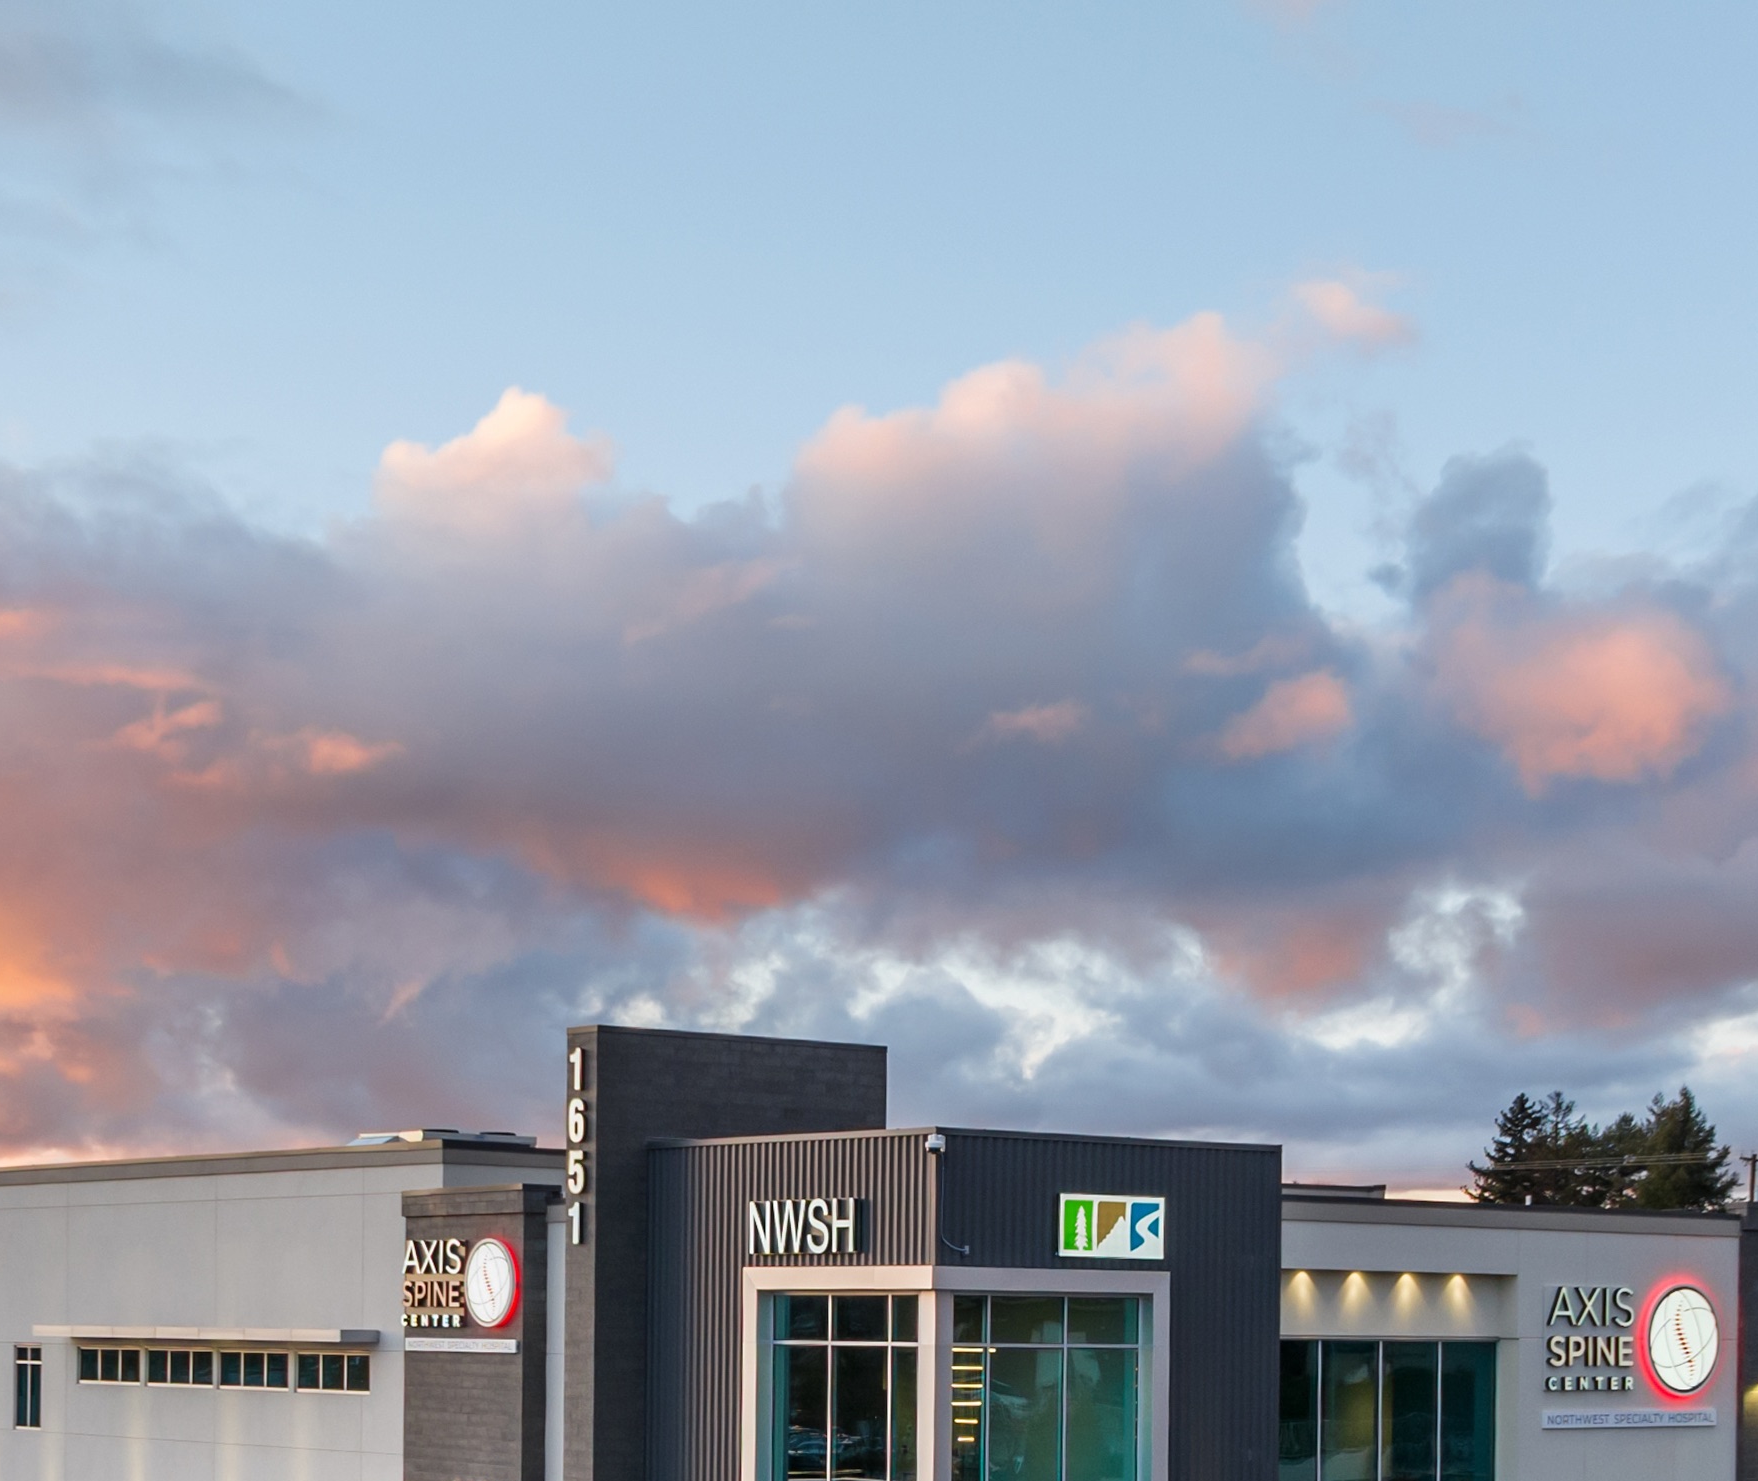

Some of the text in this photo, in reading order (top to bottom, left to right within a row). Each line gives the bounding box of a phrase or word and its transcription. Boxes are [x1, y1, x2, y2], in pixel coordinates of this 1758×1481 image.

[568, 1047, 586, 1245] 1651
[749, 1197, 855, 1255] NWSH
[401, 1238, 461, 1274] AXIS
[402, 1281, 460, 1307] SPINE
[1549, 1286, 1634, 1327] AXIS
[400, 1314, 460, 1327] CENTER
[1548, 1336, 1634, 1367] SPINE
[1547, 1376, 1634, 1391] CENTER
[1547, 1411, 1714, 1425] NORTHWEST SPECIALTY HOSPITAL
